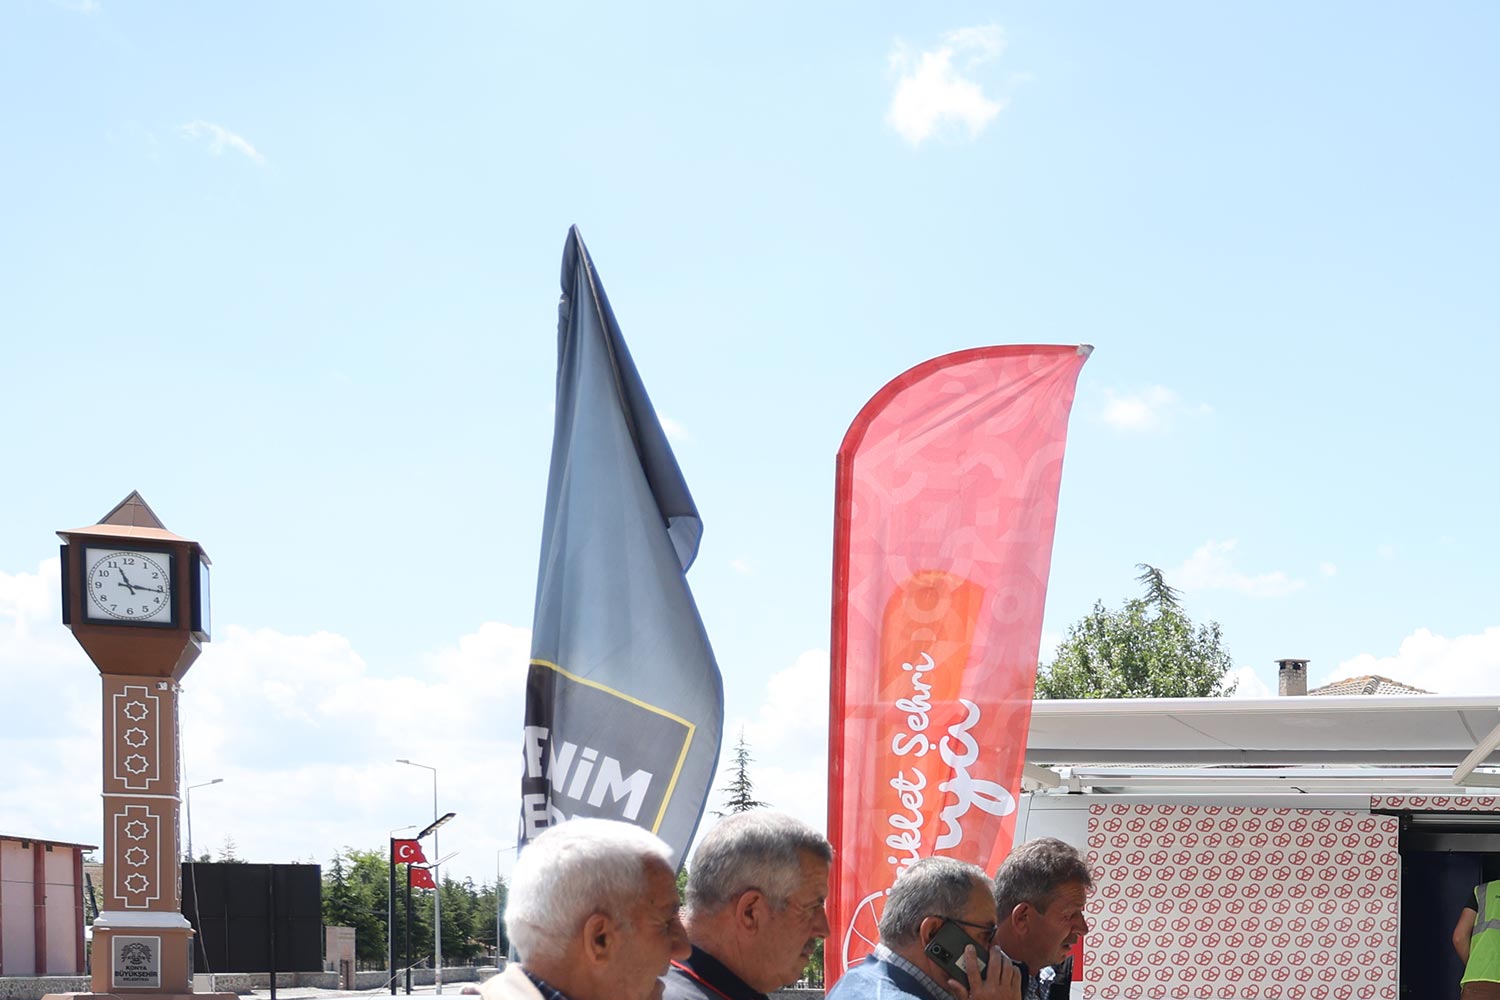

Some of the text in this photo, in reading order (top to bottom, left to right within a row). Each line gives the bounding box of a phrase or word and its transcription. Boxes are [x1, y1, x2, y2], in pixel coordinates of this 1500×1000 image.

[108, 561, 118, 569] 11
[123, 558, 135, 566] 12
[143, 562, 148, 570] 1
[98, 569, 110, 578] 10
[95, 581, 102, 589] 9
[100, 594, 107, 602] 8
[110, 604, 118, 612] 7
[126, 607, 134, 615] 6
[142, 605, 149, 613] 5
